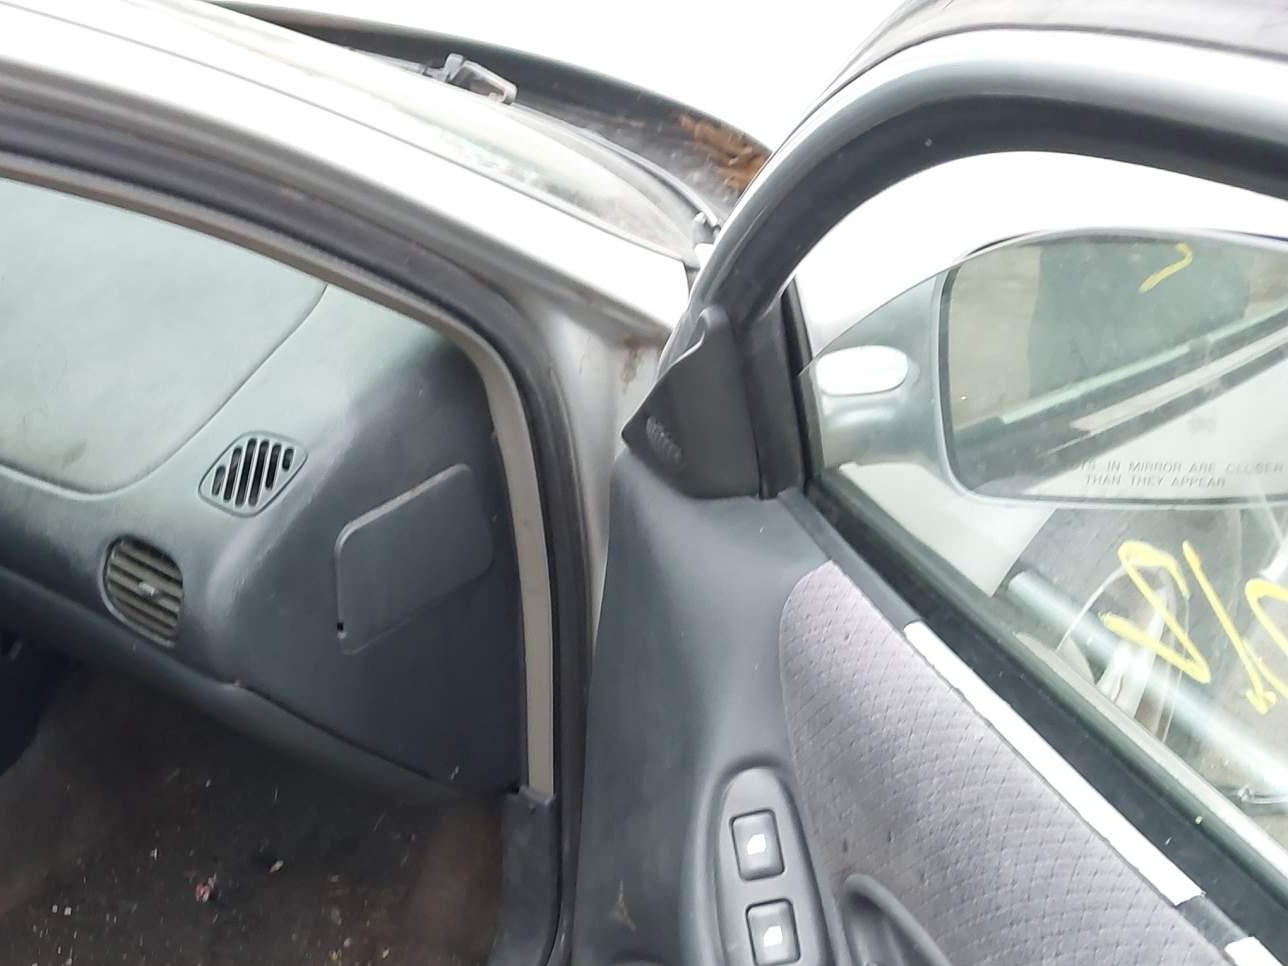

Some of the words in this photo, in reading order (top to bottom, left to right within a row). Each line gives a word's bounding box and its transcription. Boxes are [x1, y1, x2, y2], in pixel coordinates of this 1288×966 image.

[1106, 462, 1121, 473] IN
[1128, 462, 1182, 473] MIRROR
[1189, 462, 1217, 473] ARE
[1085, 474, 1122, 486] THAN
[1131, 475, 1163, 487] THEY
[1170, 476, 1226, 488] APPEAR
